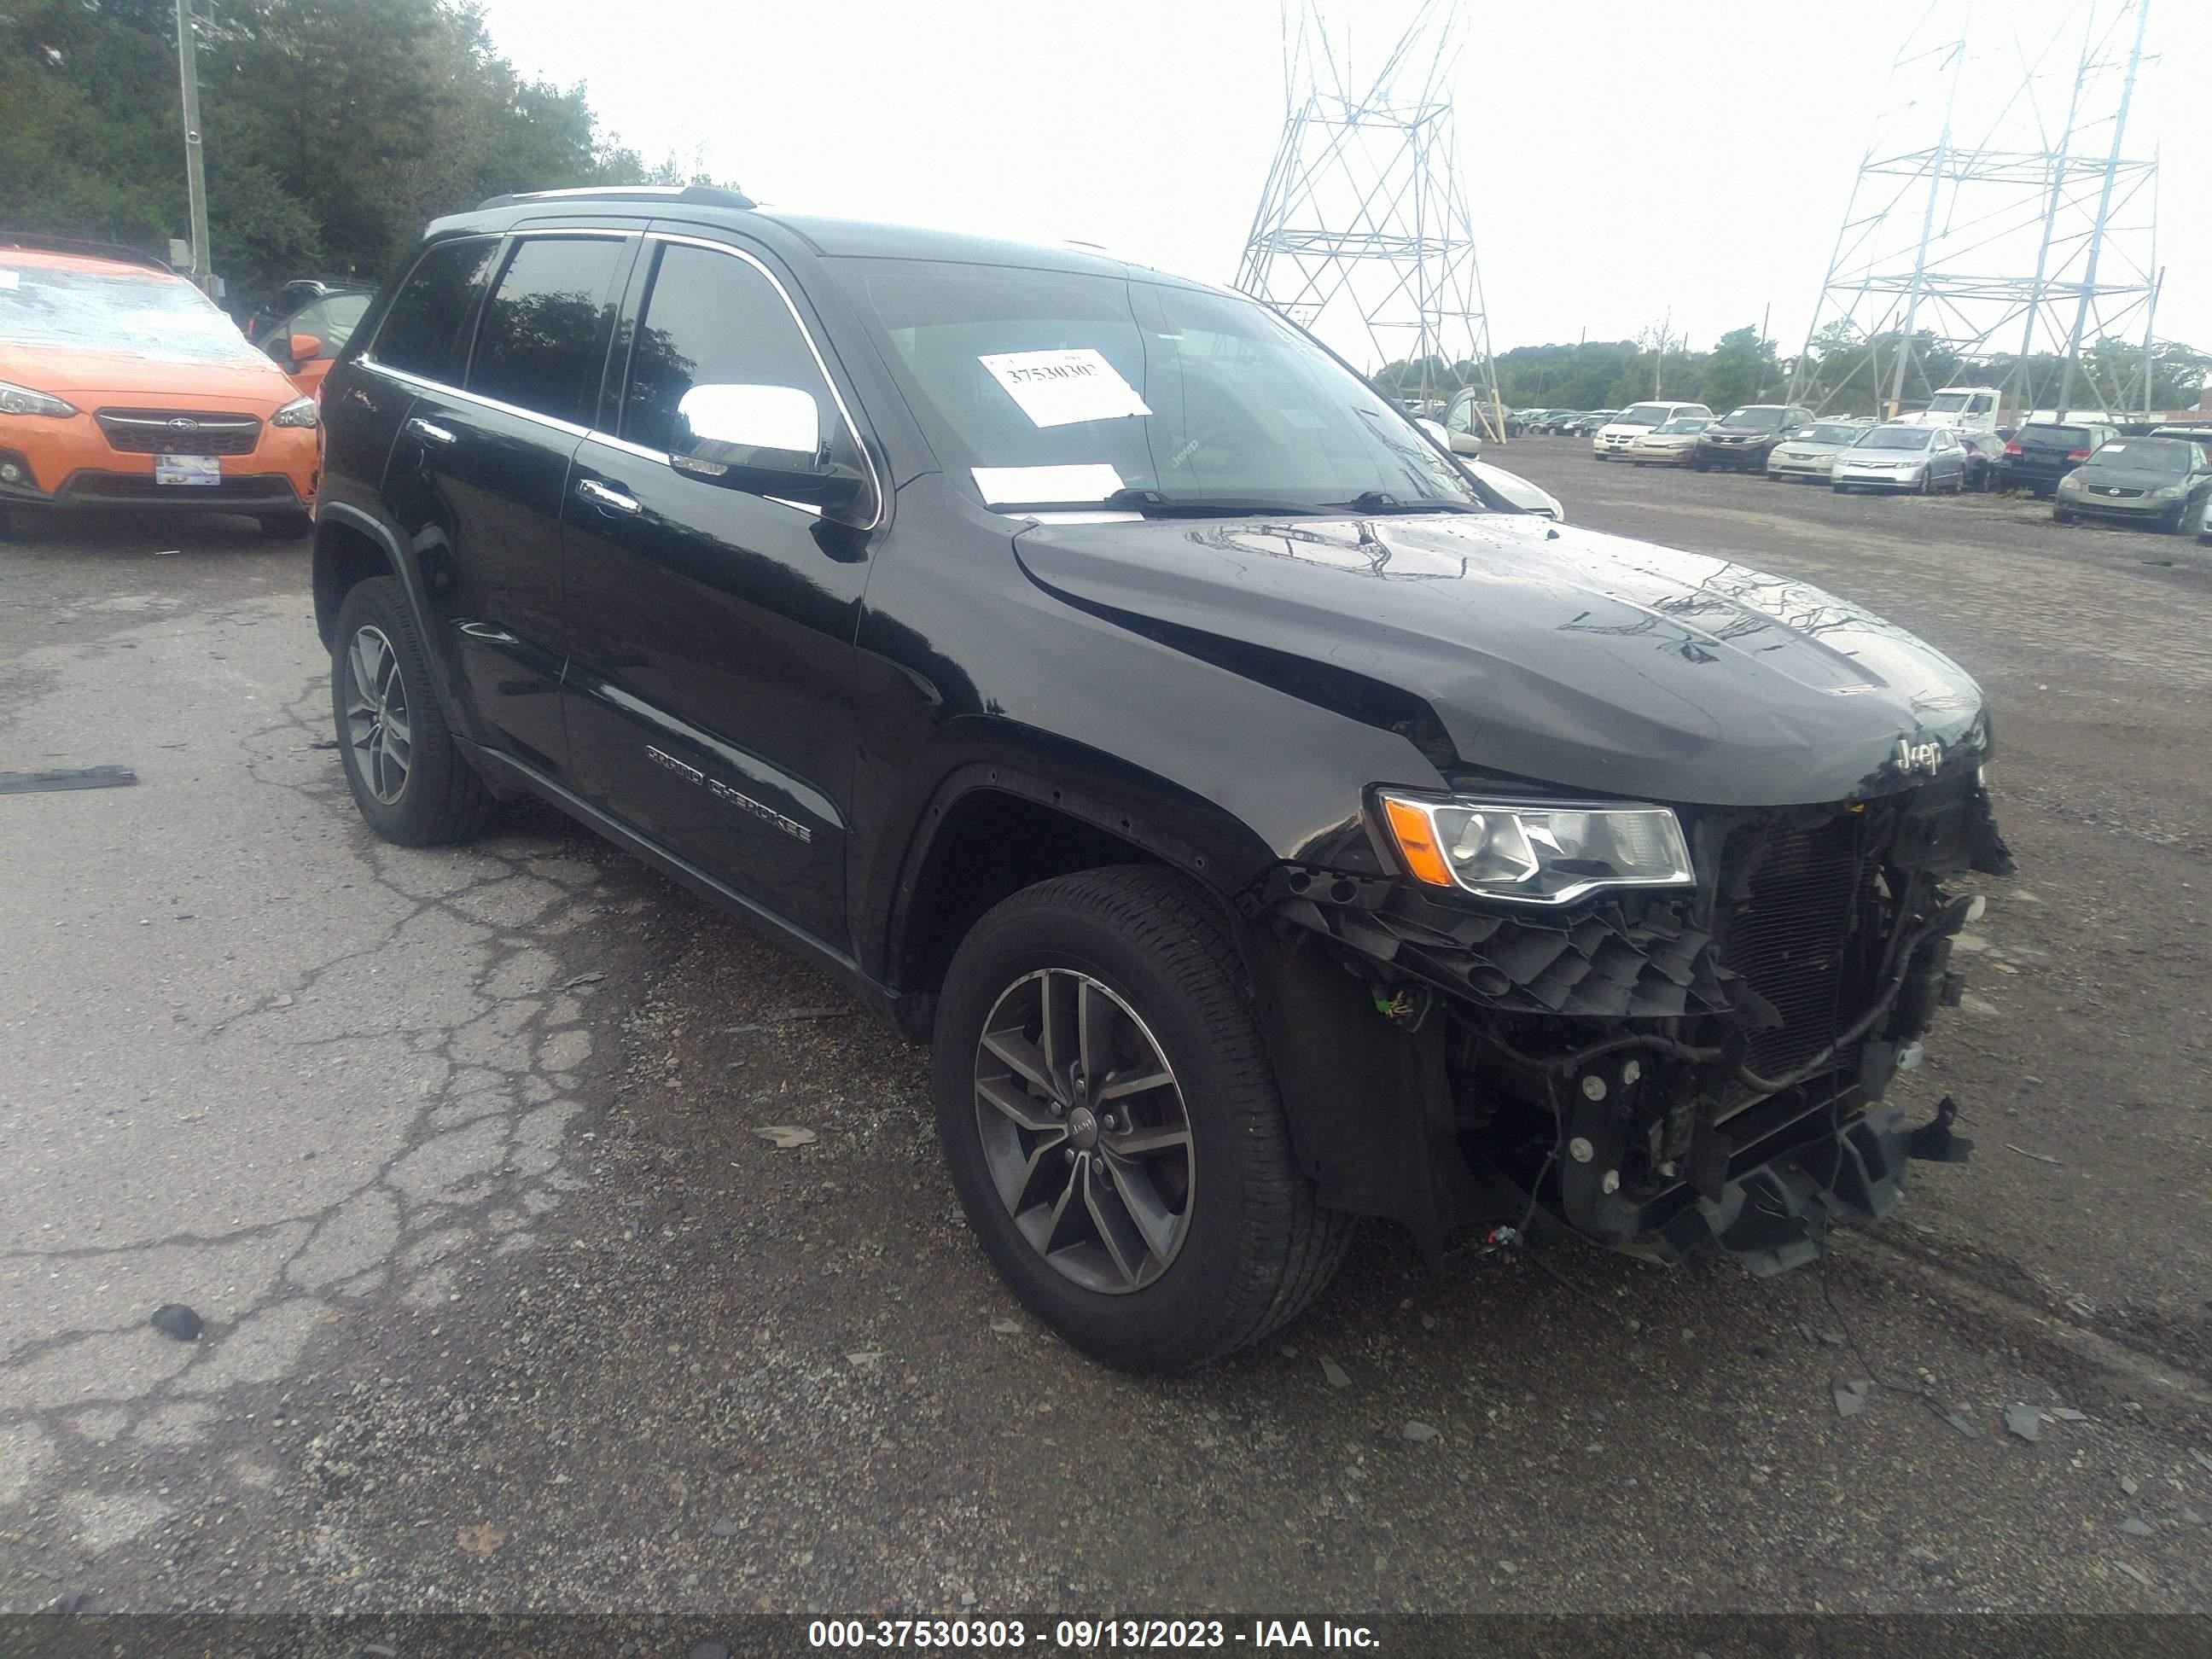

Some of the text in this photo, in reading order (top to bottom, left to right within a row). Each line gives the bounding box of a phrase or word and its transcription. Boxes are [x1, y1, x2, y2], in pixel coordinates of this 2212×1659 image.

[1895, 739, 1941, 776] Jeep
[645, 744, 812, 845] GRAND CHEROKEE
